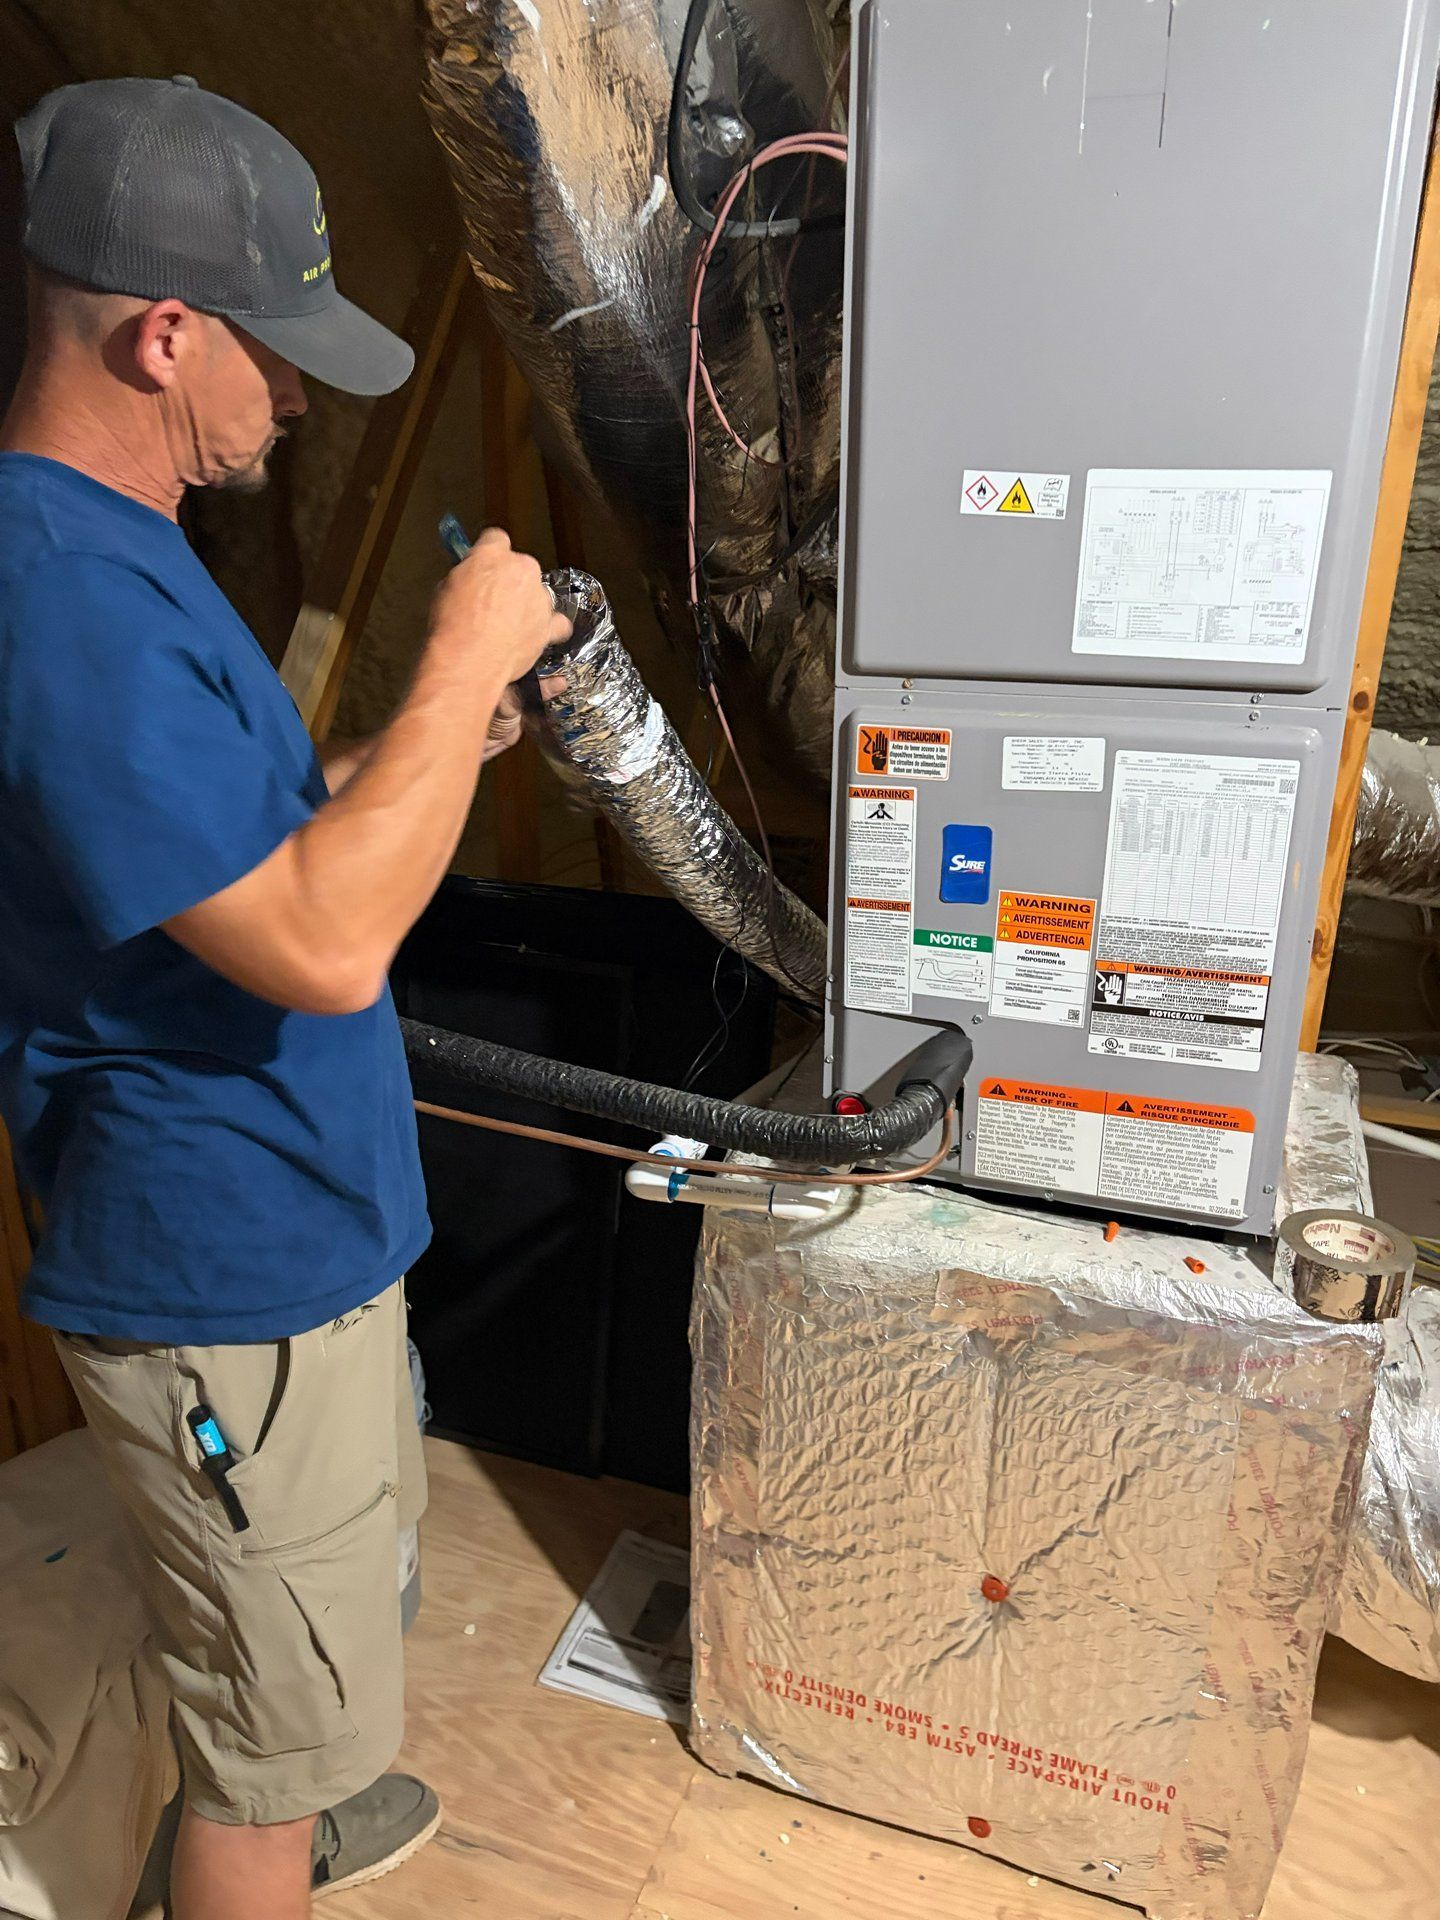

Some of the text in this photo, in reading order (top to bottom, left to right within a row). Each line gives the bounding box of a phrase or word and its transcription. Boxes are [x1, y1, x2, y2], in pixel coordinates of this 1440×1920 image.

[303, 267, 318, 282] AIR
[897, 730, 940, 743] PRECAUCION
[861, 788, 909, 799] WARNING
[948, 854, 986, 871] SURE
[857, 899, 909, 911] AVERTISSEMENT
[1015, 897, 1090, 913] WARNING
[1013, 913, 1089, 930] AVERTISSEMENT
[929, 932, 977, 948] NOTICE
[1016, 929, 1084, 945] ADVERTENCIA
[1016, 955, 1056, 965] PROPOSITION
[1024, 948, 1060, 957] CALIFORNIA
[1134, 965, 1262, 983] WARNING/AVERTISSEMENT
[1149, 1009, 1204, 1022] NOTICE/AVIS
[1014, 1094, 1037, 1102] RISK
[1019, 1087, 1065, 1098] WARNING
[1144, 1102, 1228, 1119] AVERTISSEMENT
[1140, 1110, 1239, 1128] RISQUE D'INCENDIE
[977, 1163, 988, 1171] LEAK
[990, 1165, 1016, 1176] DETECTION
[1017, 1170, 1035, 1179] SYSTEM
[1304, 1223, 1341, 1237] Nashu
[798, 1674, 868, 1707] DENSITY
[762, 1679, 855, 1721] REFLECTIX
[872, 1698, 933, 1728] SMOKE
[884, 1719, 918, 1740] E84
[959, 1725, 970, 1739] 5
[925, 1731, 976, 1757] ASTM
[975, 1731, 1043, 1762] SPREAD
[1049, 1752, 1109, 1781] FLAME
[1005, 1756, 1103, 1797] AIRSPACE
